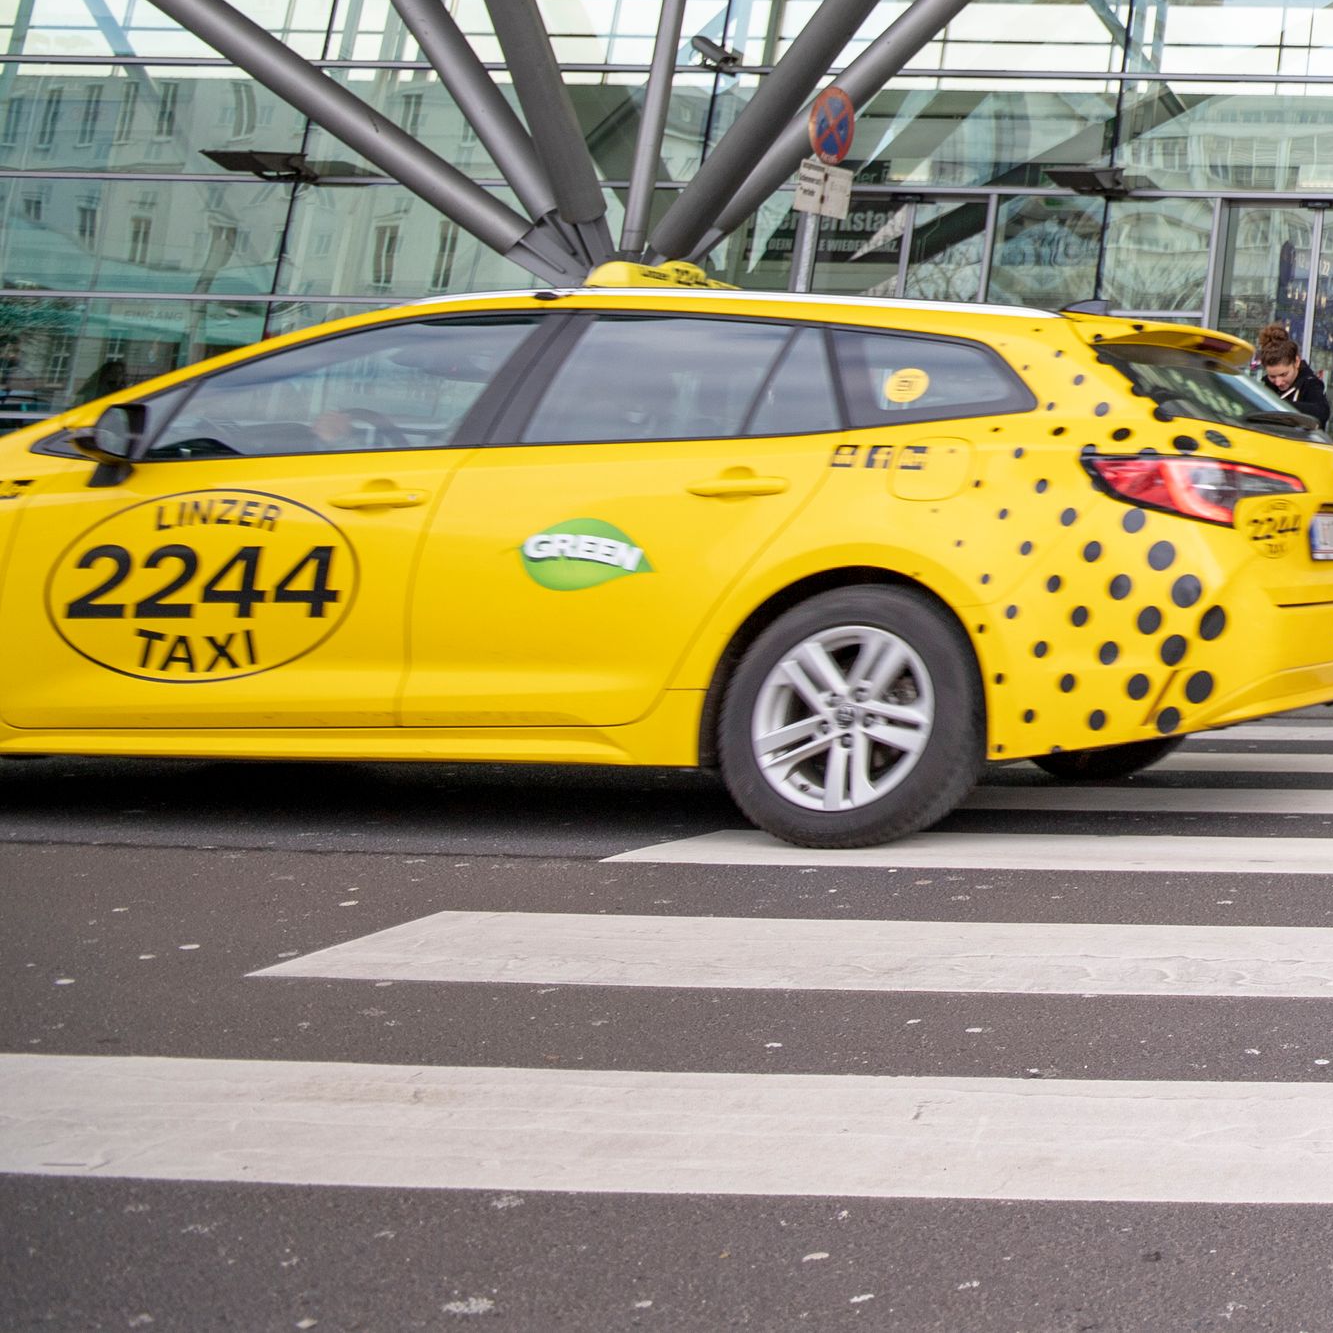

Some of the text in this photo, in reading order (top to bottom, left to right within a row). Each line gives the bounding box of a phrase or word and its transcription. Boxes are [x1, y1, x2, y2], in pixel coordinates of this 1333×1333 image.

[155, 498, 283, 532] LINZER
[522, 532, 645, 572] GREEN
[66, 543, 342, 619] 2244
[134, 628, 259, 673] TAXI
